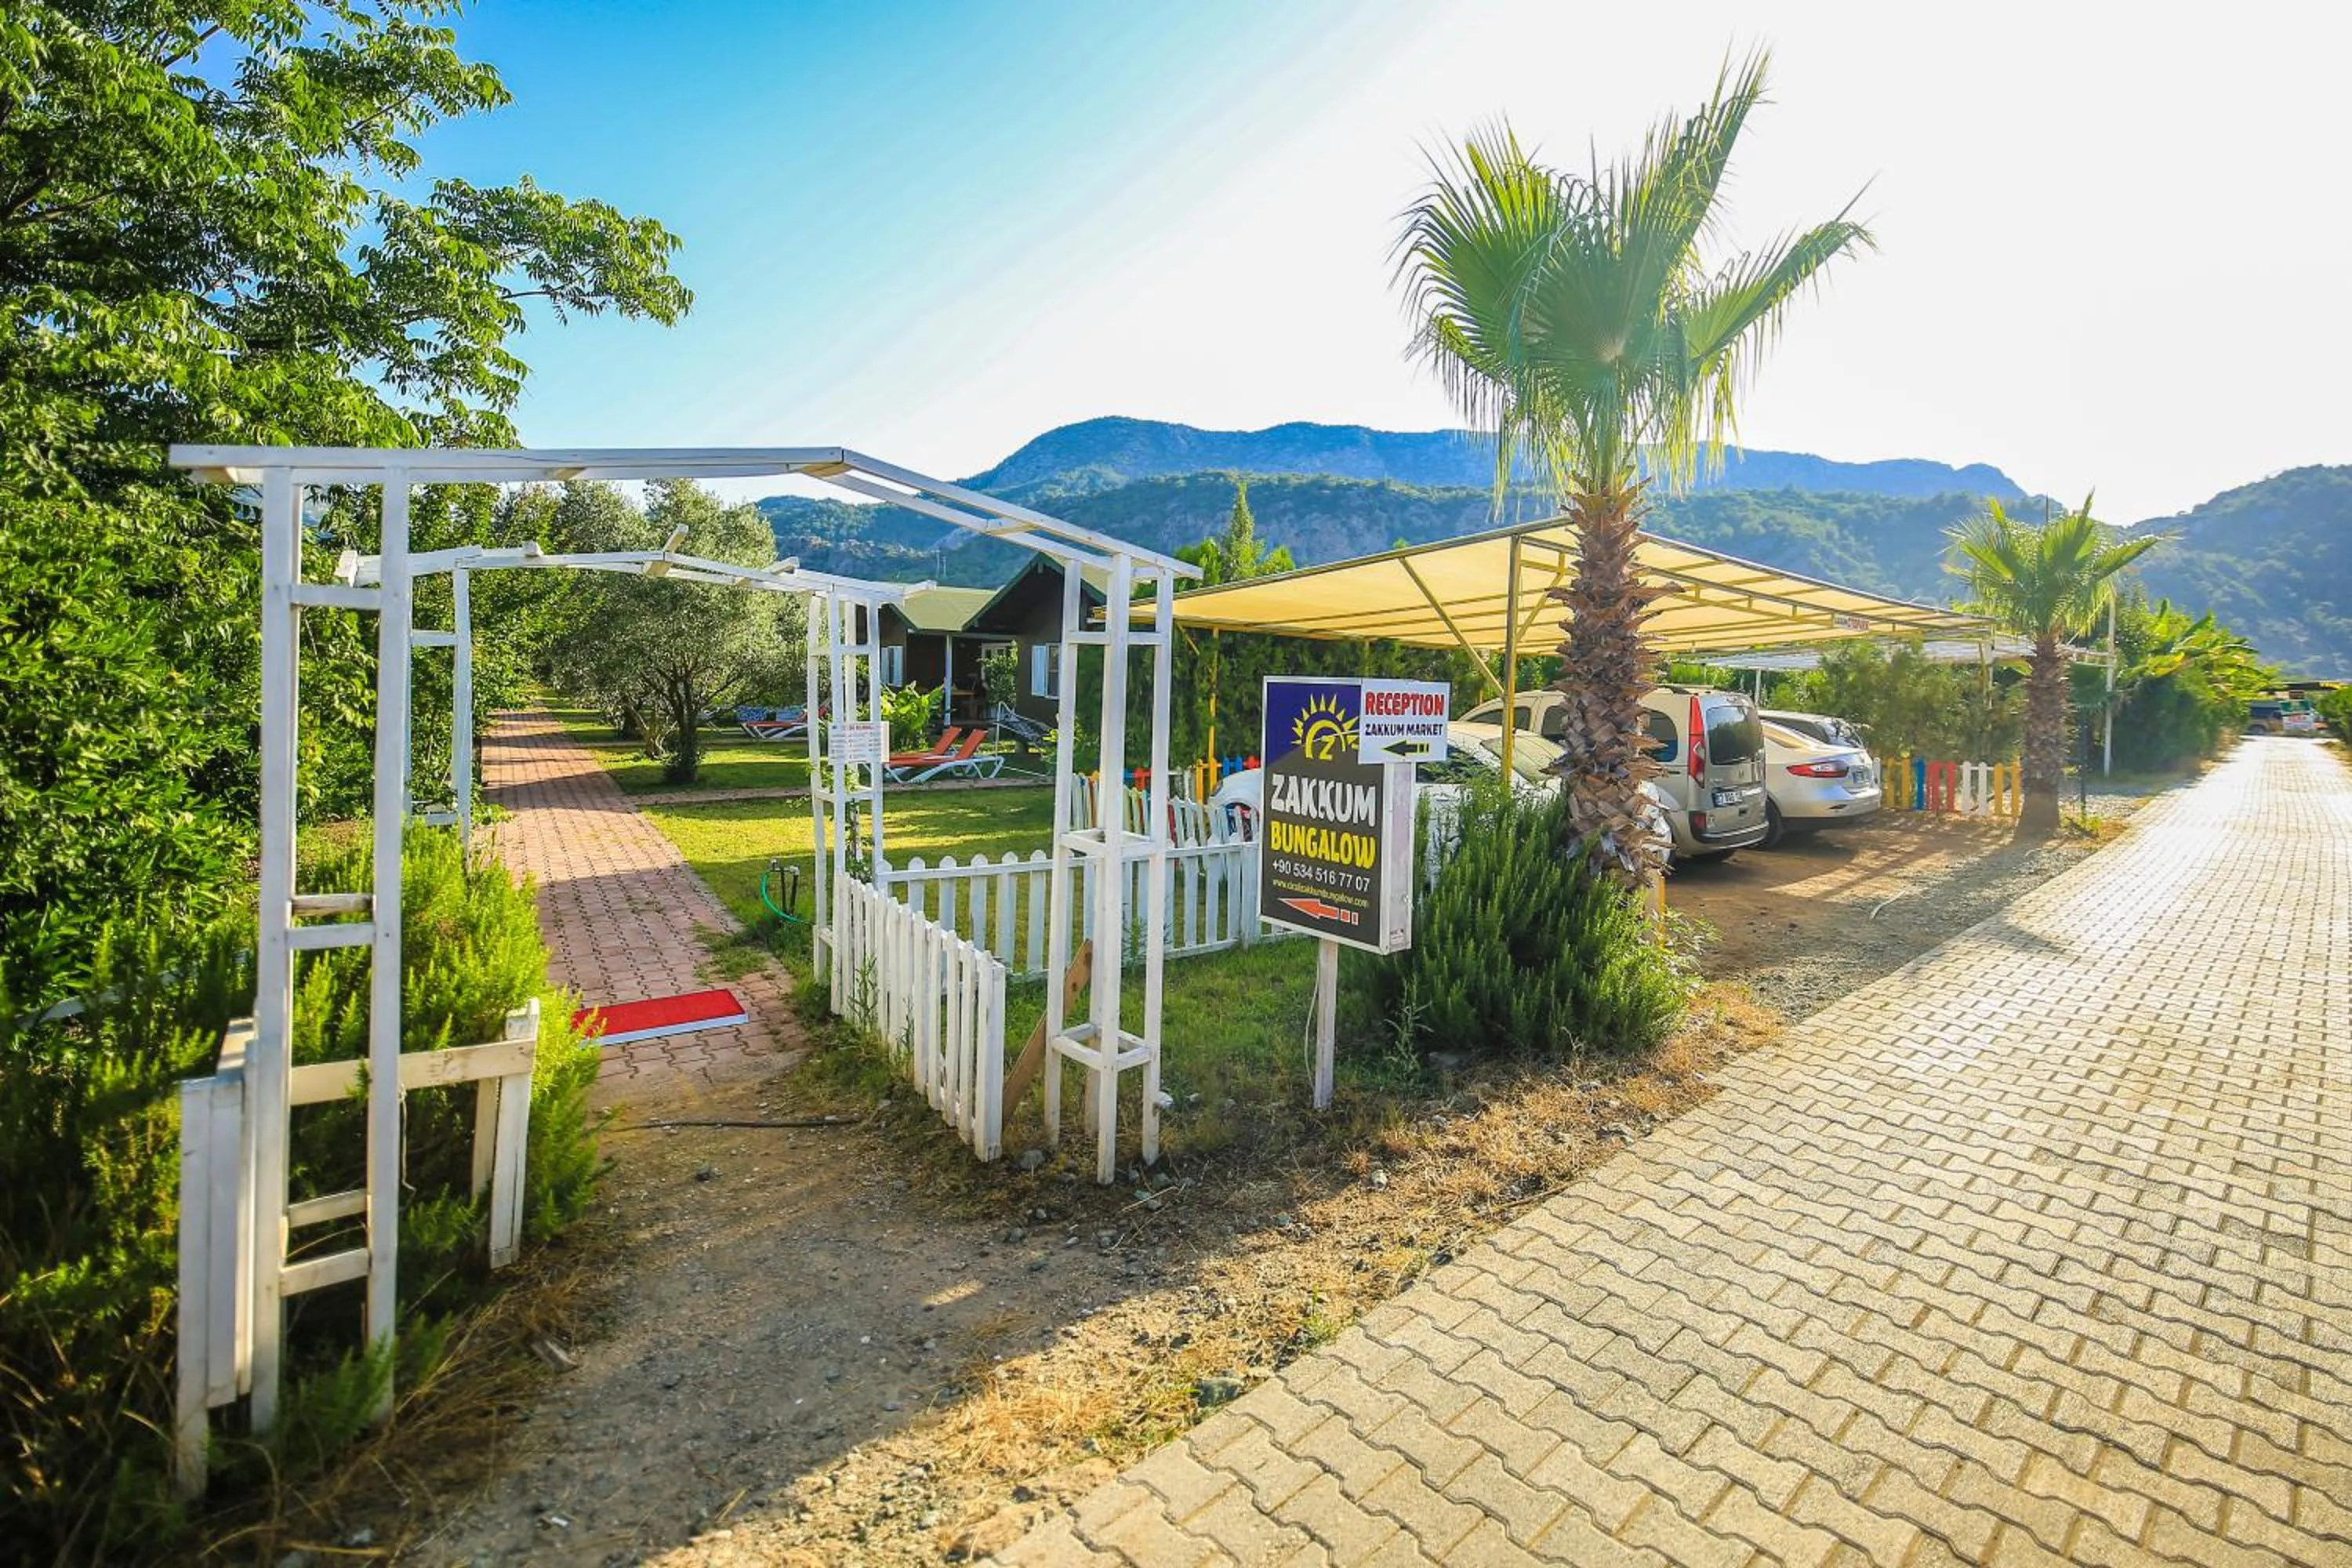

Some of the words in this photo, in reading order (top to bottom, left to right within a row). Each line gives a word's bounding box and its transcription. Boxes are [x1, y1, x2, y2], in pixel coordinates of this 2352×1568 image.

[1365, 691, 1444, 716] RECEPTION
[1365, 724, 1405, 736] ZAKKUM
[1406, 724, 1443, 735] MARKET
[1271, 773, 1376, 827] ZAKKUM
[1271, 820, 1376, 869] BUNGALOW
[1272, 858, 1291, 875] +90
[1293, 863, 1313, 880] 534
[1316, 867, 1336, 885] 516
[1338, 873, 1352, 888] 77
[1356, 876, 1370, 892] 07
